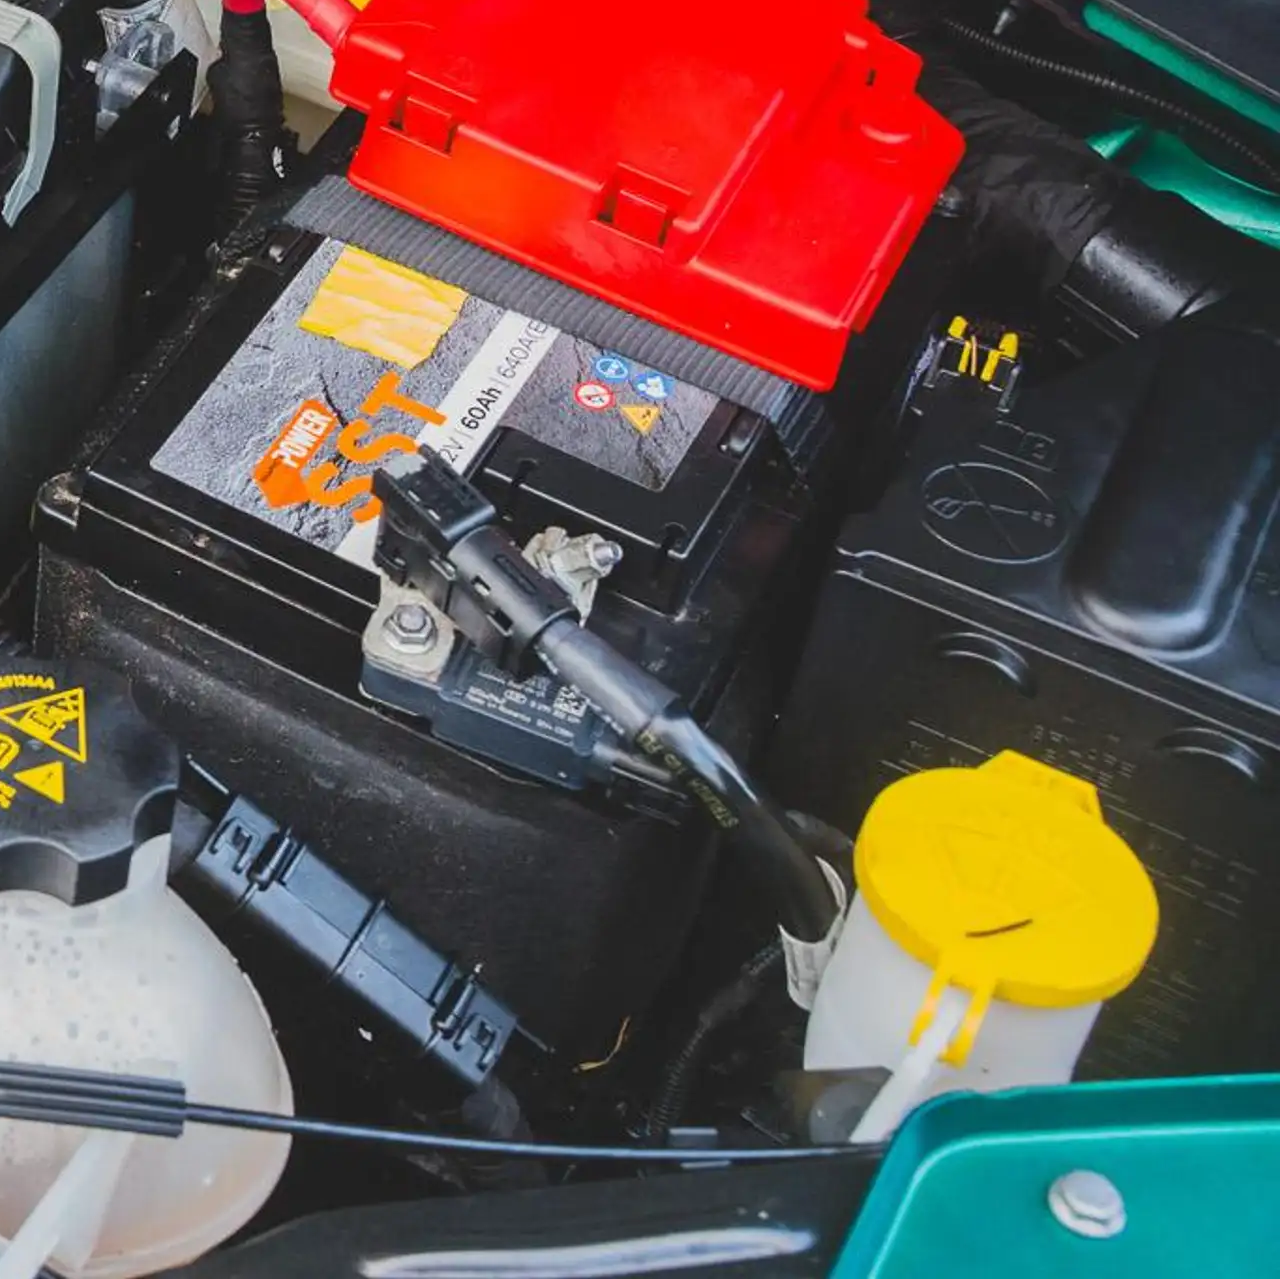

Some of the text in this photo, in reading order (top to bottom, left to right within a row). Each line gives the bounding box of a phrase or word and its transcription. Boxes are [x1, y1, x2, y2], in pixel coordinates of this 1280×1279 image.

[270, 408, 333, 469] POWER
[438, 319, 548, 464] 2V 60Ah 640A(E
